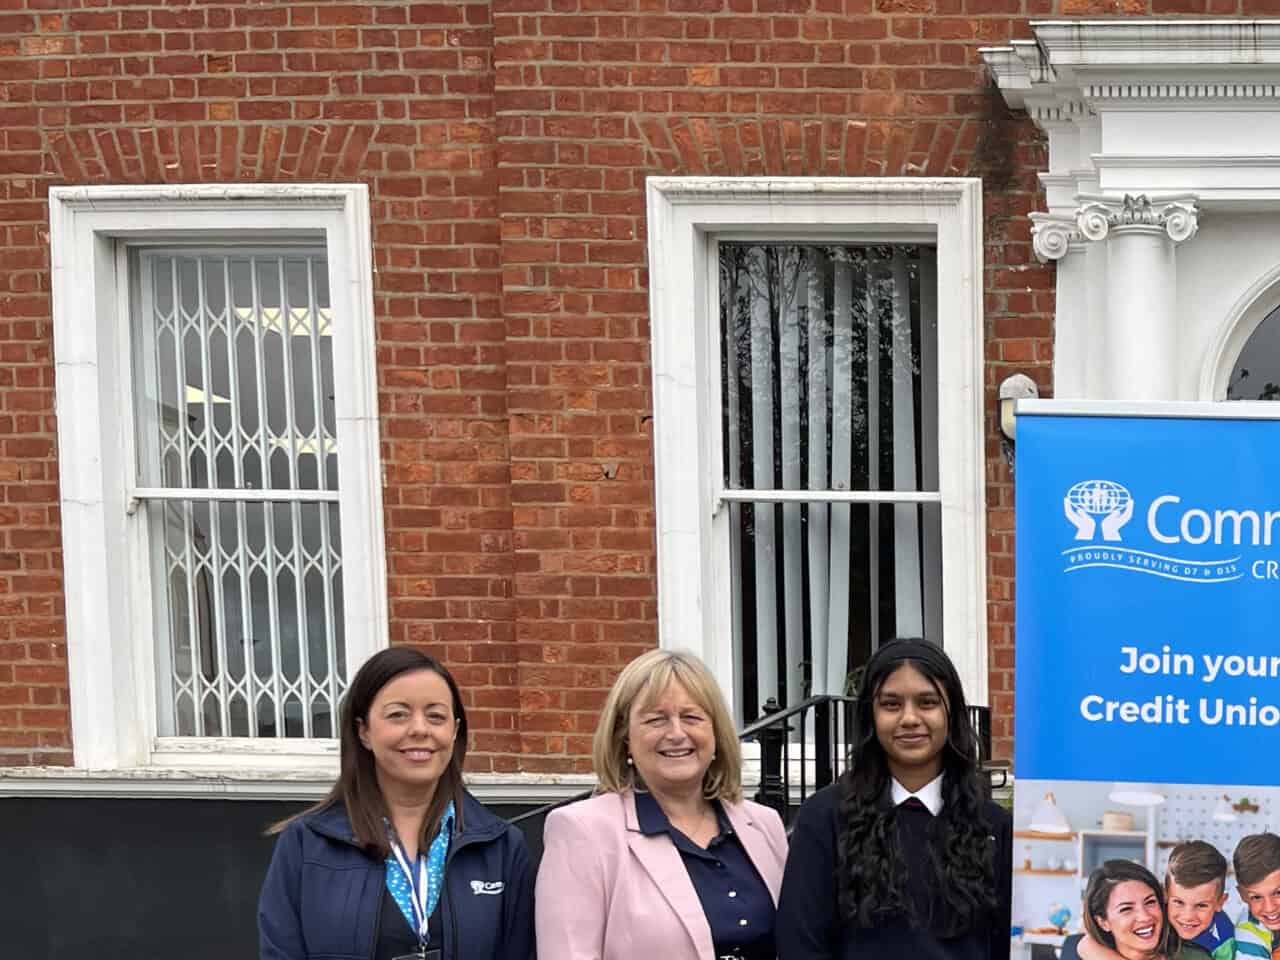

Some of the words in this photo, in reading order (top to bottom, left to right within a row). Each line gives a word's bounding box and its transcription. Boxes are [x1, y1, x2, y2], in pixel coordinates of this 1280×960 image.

[1070, 552, 1123, 563] PROUDLY
[1128, 556, 1178, 574] SERVING
[1119, 645, 1194, 675] Join
[1080, 694, 1190, 724] Credit
